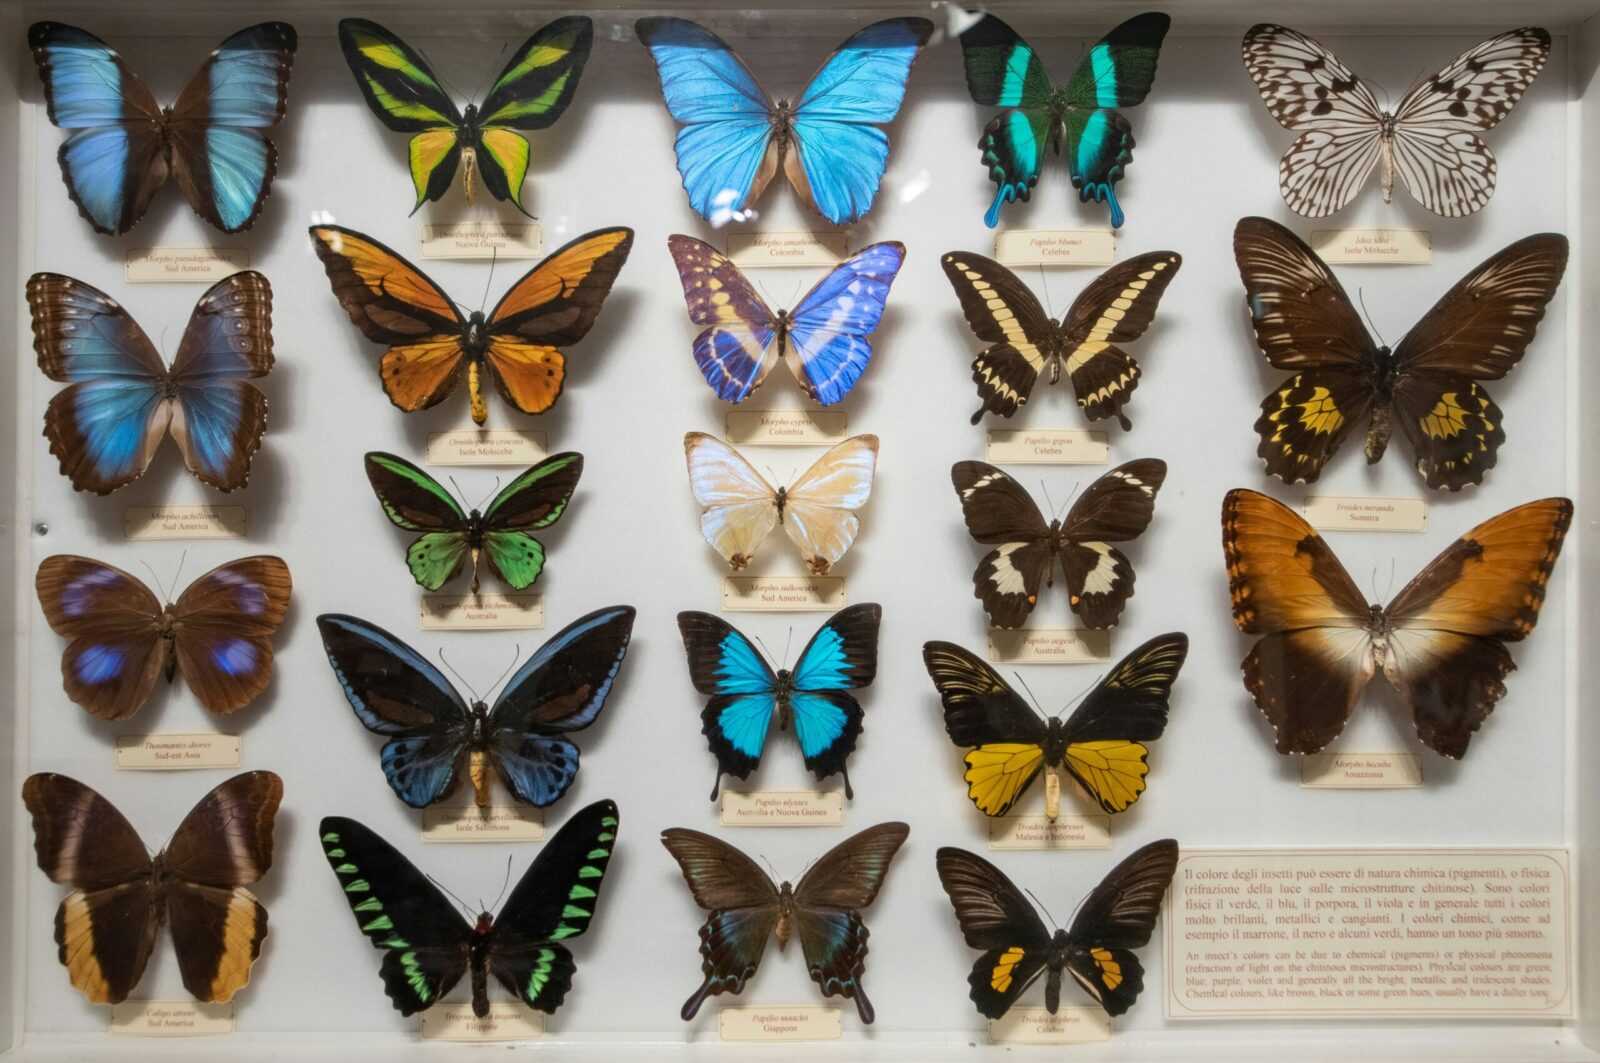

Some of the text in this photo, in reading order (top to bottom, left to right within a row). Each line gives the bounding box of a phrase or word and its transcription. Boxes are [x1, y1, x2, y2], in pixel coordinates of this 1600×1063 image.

[181, 264, 211, 272] America
[762, 594, 807, 602] Sud America
[1196, 869, 1229, 879] colore
[1232, 869, 1257, 881] degli
[1262, 869, 1293, 879] insetti
[1320, 871, 1351, 879] essere
[1368, 869, 1401, 878] natura
[1404, 869, 1446, 878] chimica
[1521, 868, 1550, 878] fisica
[1185, 884, 1240, 895] (rifrazione
[1248, 884, 1272, 894] della
[1280, 884, 1301, 894] luce
[1310, 884, 1334, 894] sulle
[1341, 884, 1415, 894] microstrutture
[1485, 883, 1512, 893] Sono
[1520, 883, 1550, 893] colori
[1186, 898, 1211, 909] fisici
[1377, 898, 1403, 909] viola
[1434, 898, 1479, 911] generale
[1484, 898, 1504, 908] tutti
[1520, 898, 1550, 908] colori
[1185, 914, 1216, 925] molto
[1275, 914, 1321, 924] metallici
[1412, 914, 1443, 924] colori
[1501, 916, 1530, 924] come
[1185, 929, 1229, 942] esempio
[1303, 931, 1326, 939] nero
[1338, 929, 1370, 939] alcuni
[1407, 929, 1438, 939] hanno
[1458, 928, 1482, 938] tono
[1311, 951, 1327, 960] due
[1347, 951, 1386, 959] chemical
[1391, 951, 1439, 961] (pigments)
[1459, 950, 1496, 961] physical
